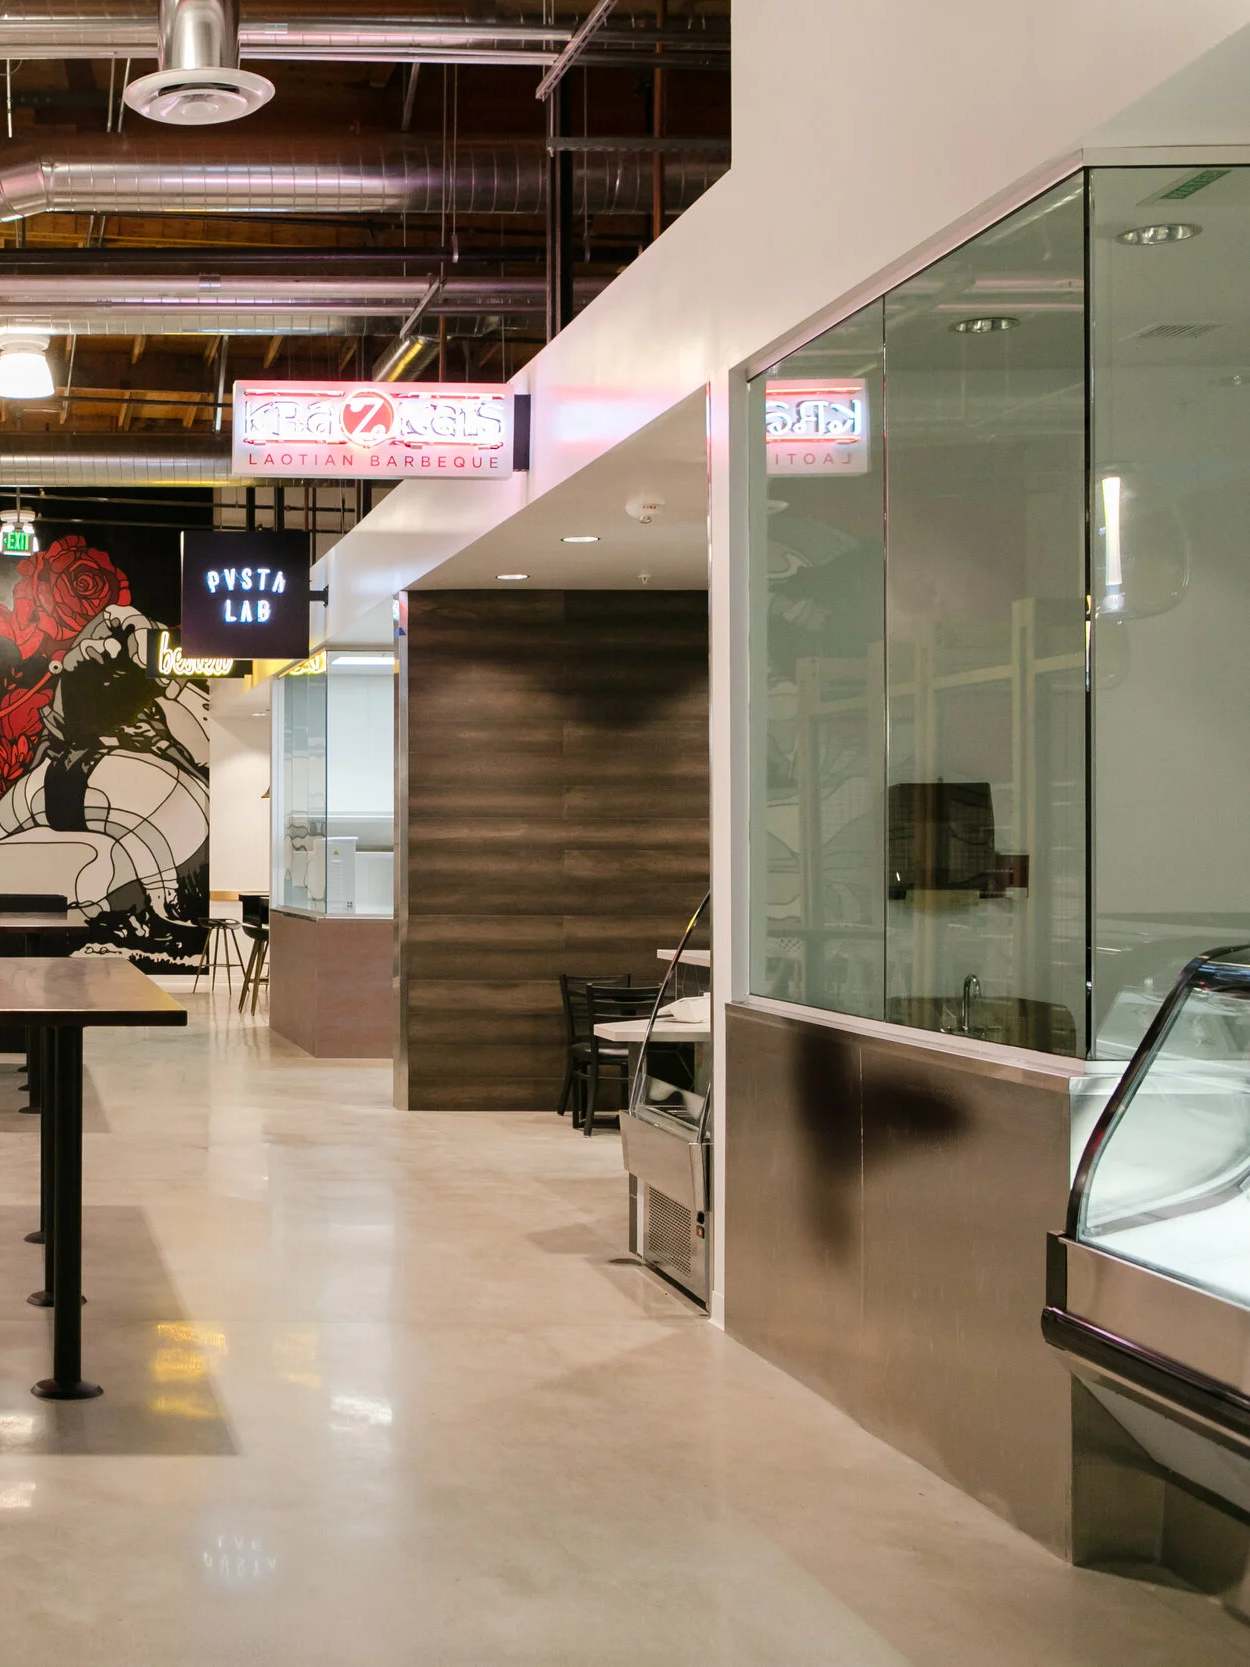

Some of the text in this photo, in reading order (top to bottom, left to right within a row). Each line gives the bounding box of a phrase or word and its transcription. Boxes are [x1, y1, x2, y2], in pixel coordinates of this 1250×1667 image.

[248, 453, 500, 469] LAOTIAN BARBEQUE
[6, 531, 30, 551] EXIT
[225, 599, 272, 623] LAB
